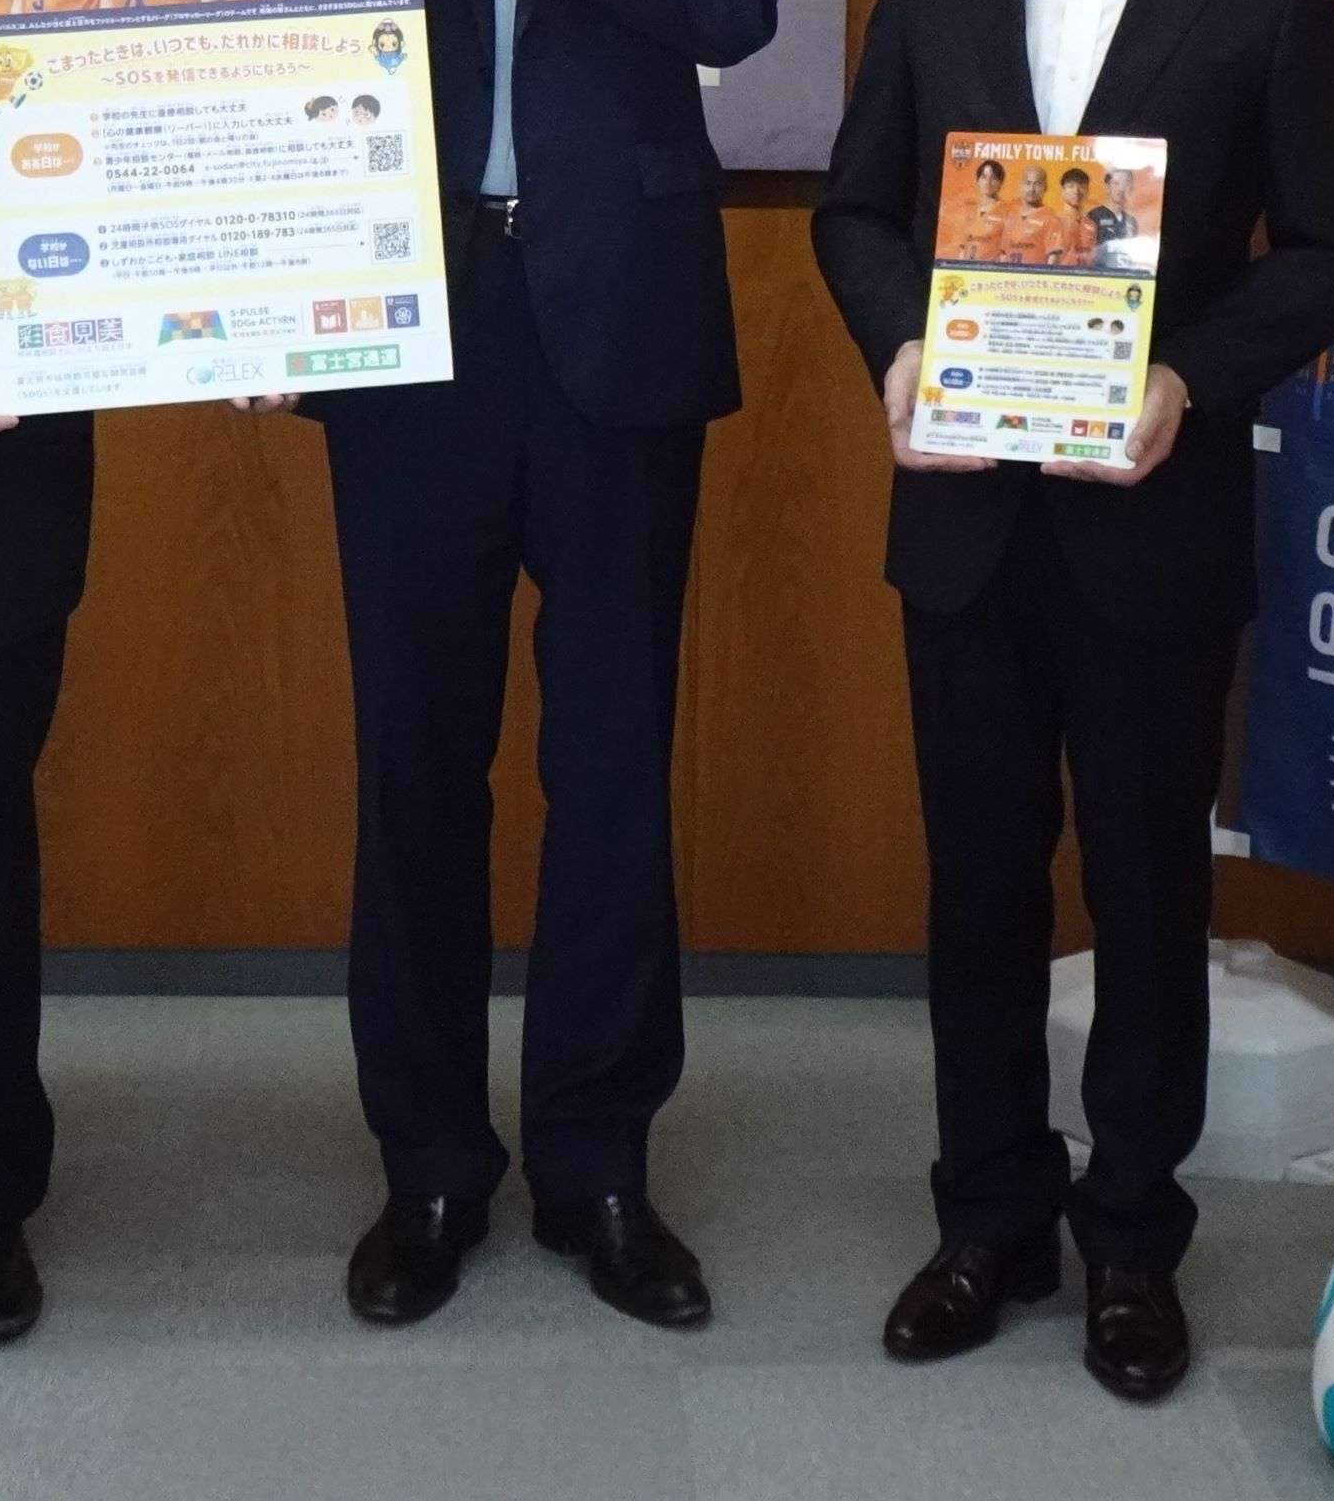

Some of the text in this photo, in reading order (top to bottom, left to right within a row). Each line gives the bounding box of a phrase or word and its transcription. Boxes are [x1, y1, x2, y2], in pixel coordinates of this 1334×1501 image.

[974, 142, 1023, 160] FAMILY
[105, 163, 195, 179] 0544-22-0064
[214, 211, 295, 226] 0120-0-78310
[219, 227, 294, 242] 0120-189-783
